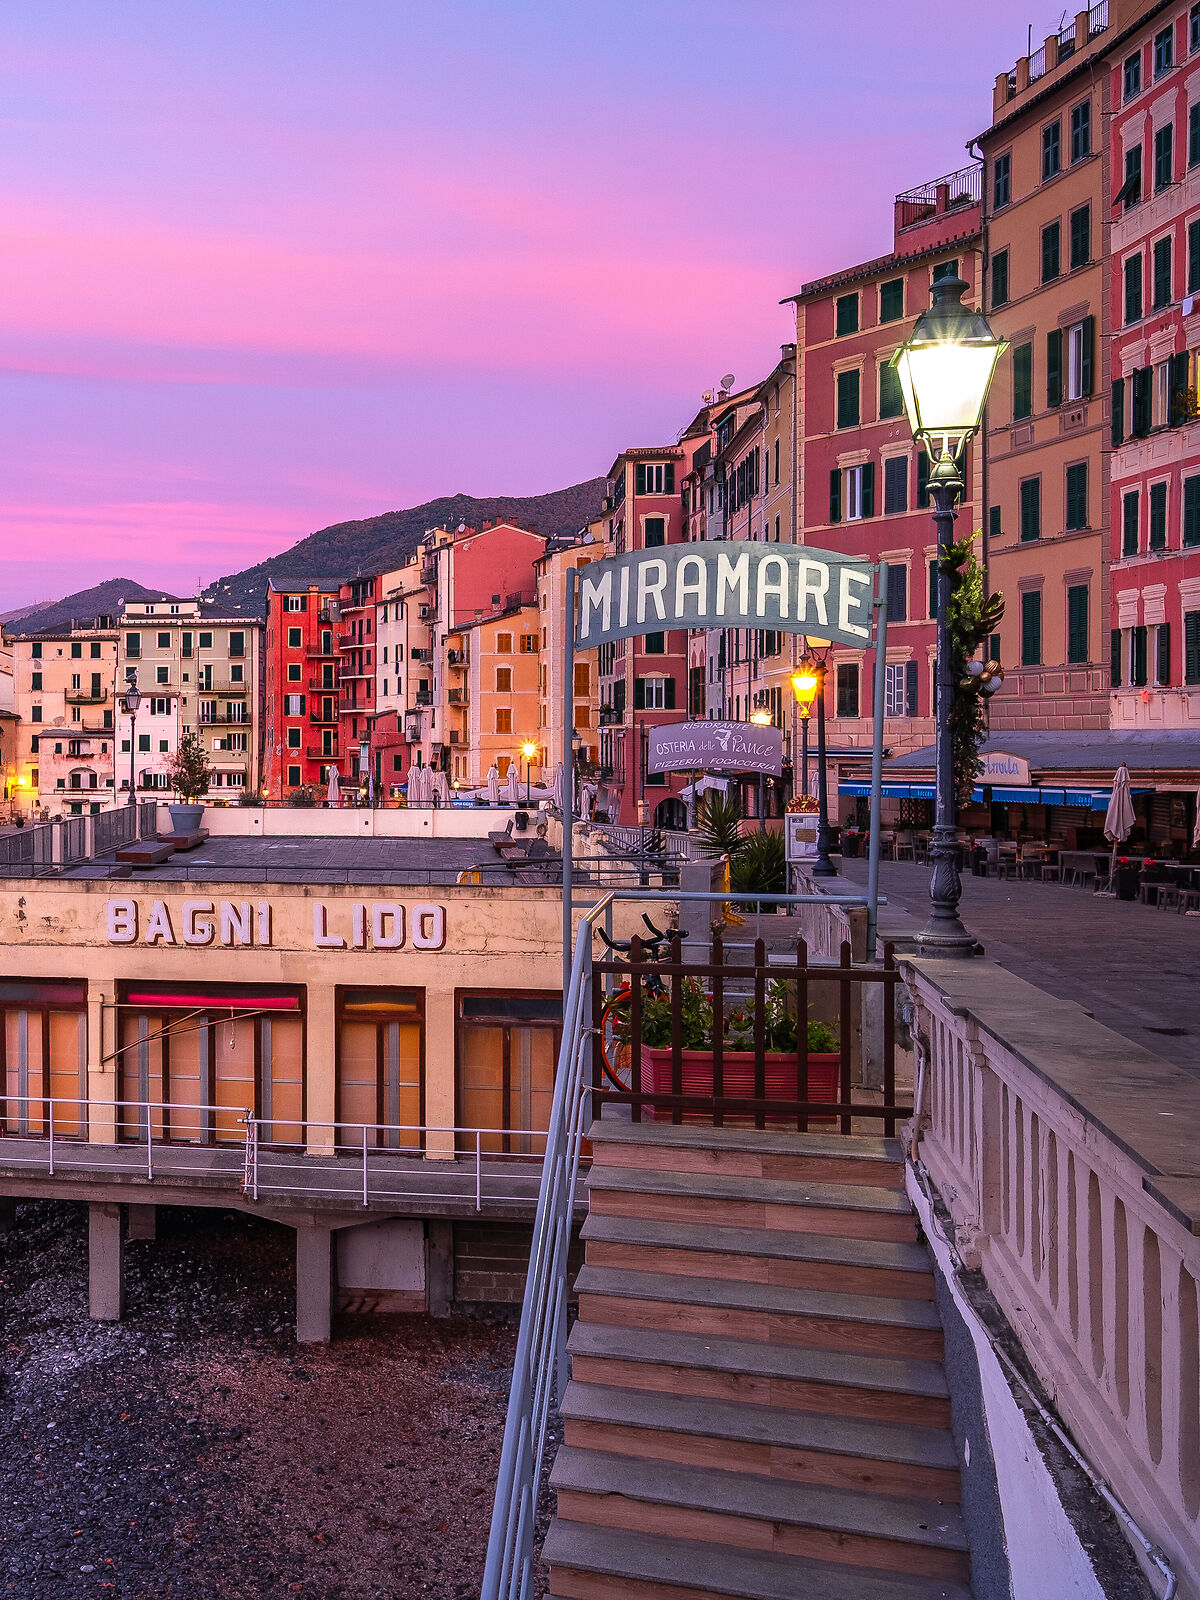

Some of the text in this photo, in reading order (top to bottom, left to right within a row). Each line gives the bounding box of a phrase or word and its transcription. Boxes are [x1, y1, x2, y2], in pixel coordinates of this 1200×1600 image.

[579, 552, 871, 640] MIRAMARE
[682, 722, 750, 731] RISTORANTE
[656, 740, 696, 755] OSTERIA
[698, 741, 716, 751] delle
[732, 734, 774, 757] Pance
[654, 757, 776, 771] PIZZERIA FOCACCERIA
[105, 899, 448, 951] BAGNI LIDO
